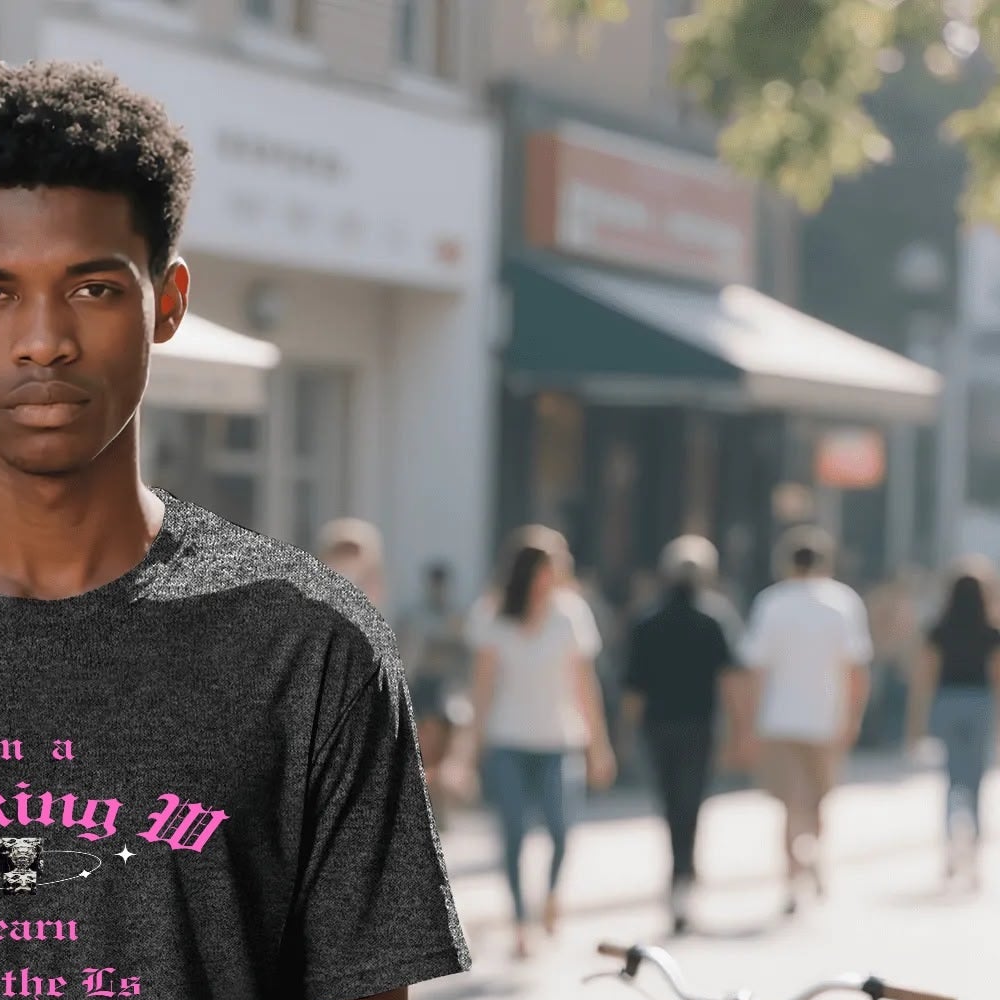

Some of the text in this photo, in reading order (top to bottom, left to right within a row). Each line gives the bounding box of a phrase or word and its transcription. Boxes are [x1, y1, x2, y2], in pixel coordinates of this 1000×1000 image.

[52, 738, 75, 761] a
[136, 792, 230, 853] W
[82, 967, 142, 998] Ls
